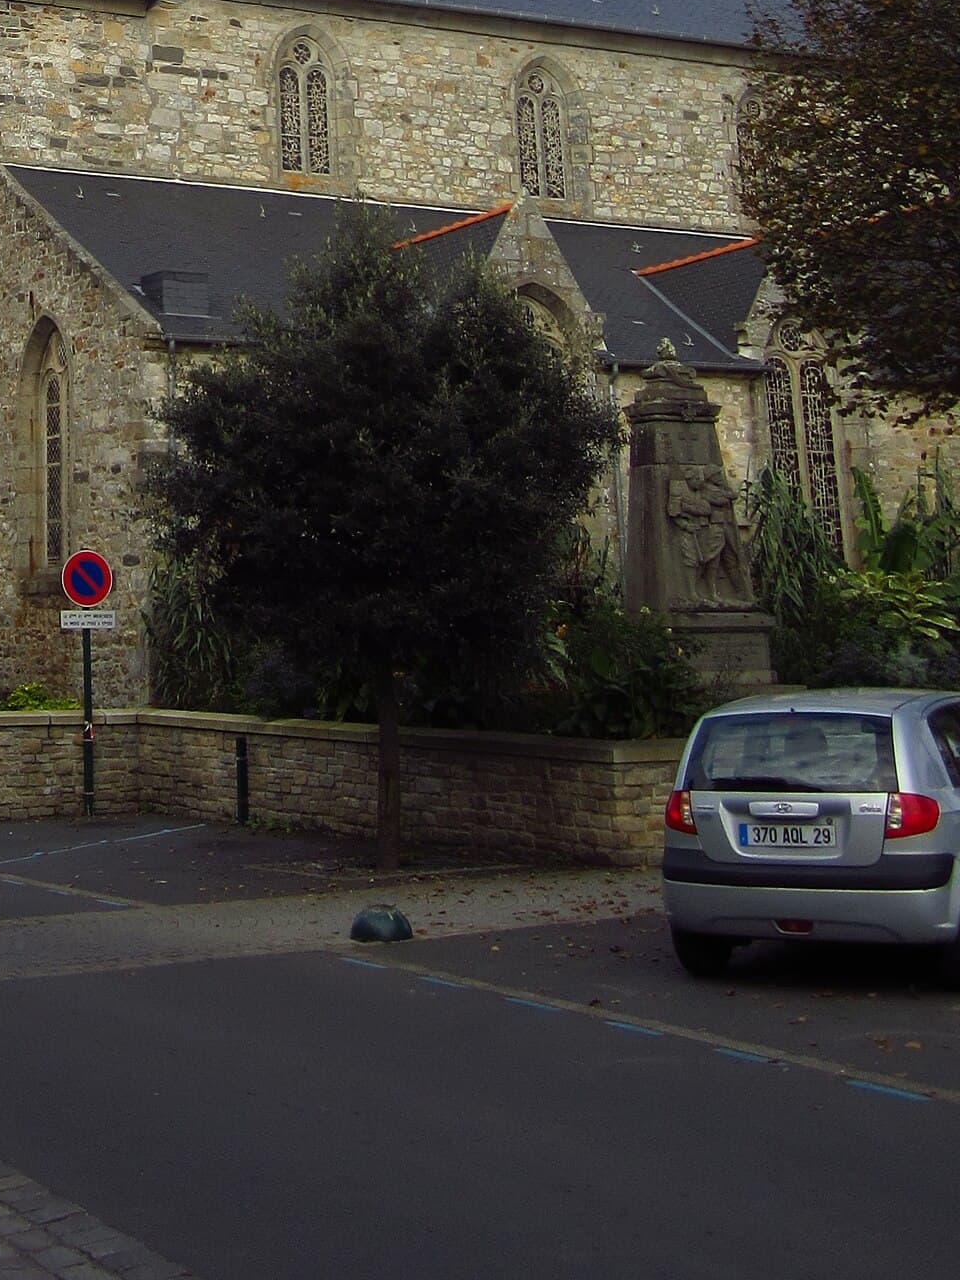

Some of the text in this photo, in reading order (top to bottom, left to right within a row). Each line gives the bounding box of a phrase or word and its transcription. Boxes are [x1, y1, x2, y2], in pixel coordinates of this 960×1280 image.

[752, 827, 831, 844] 370 AQL 29
